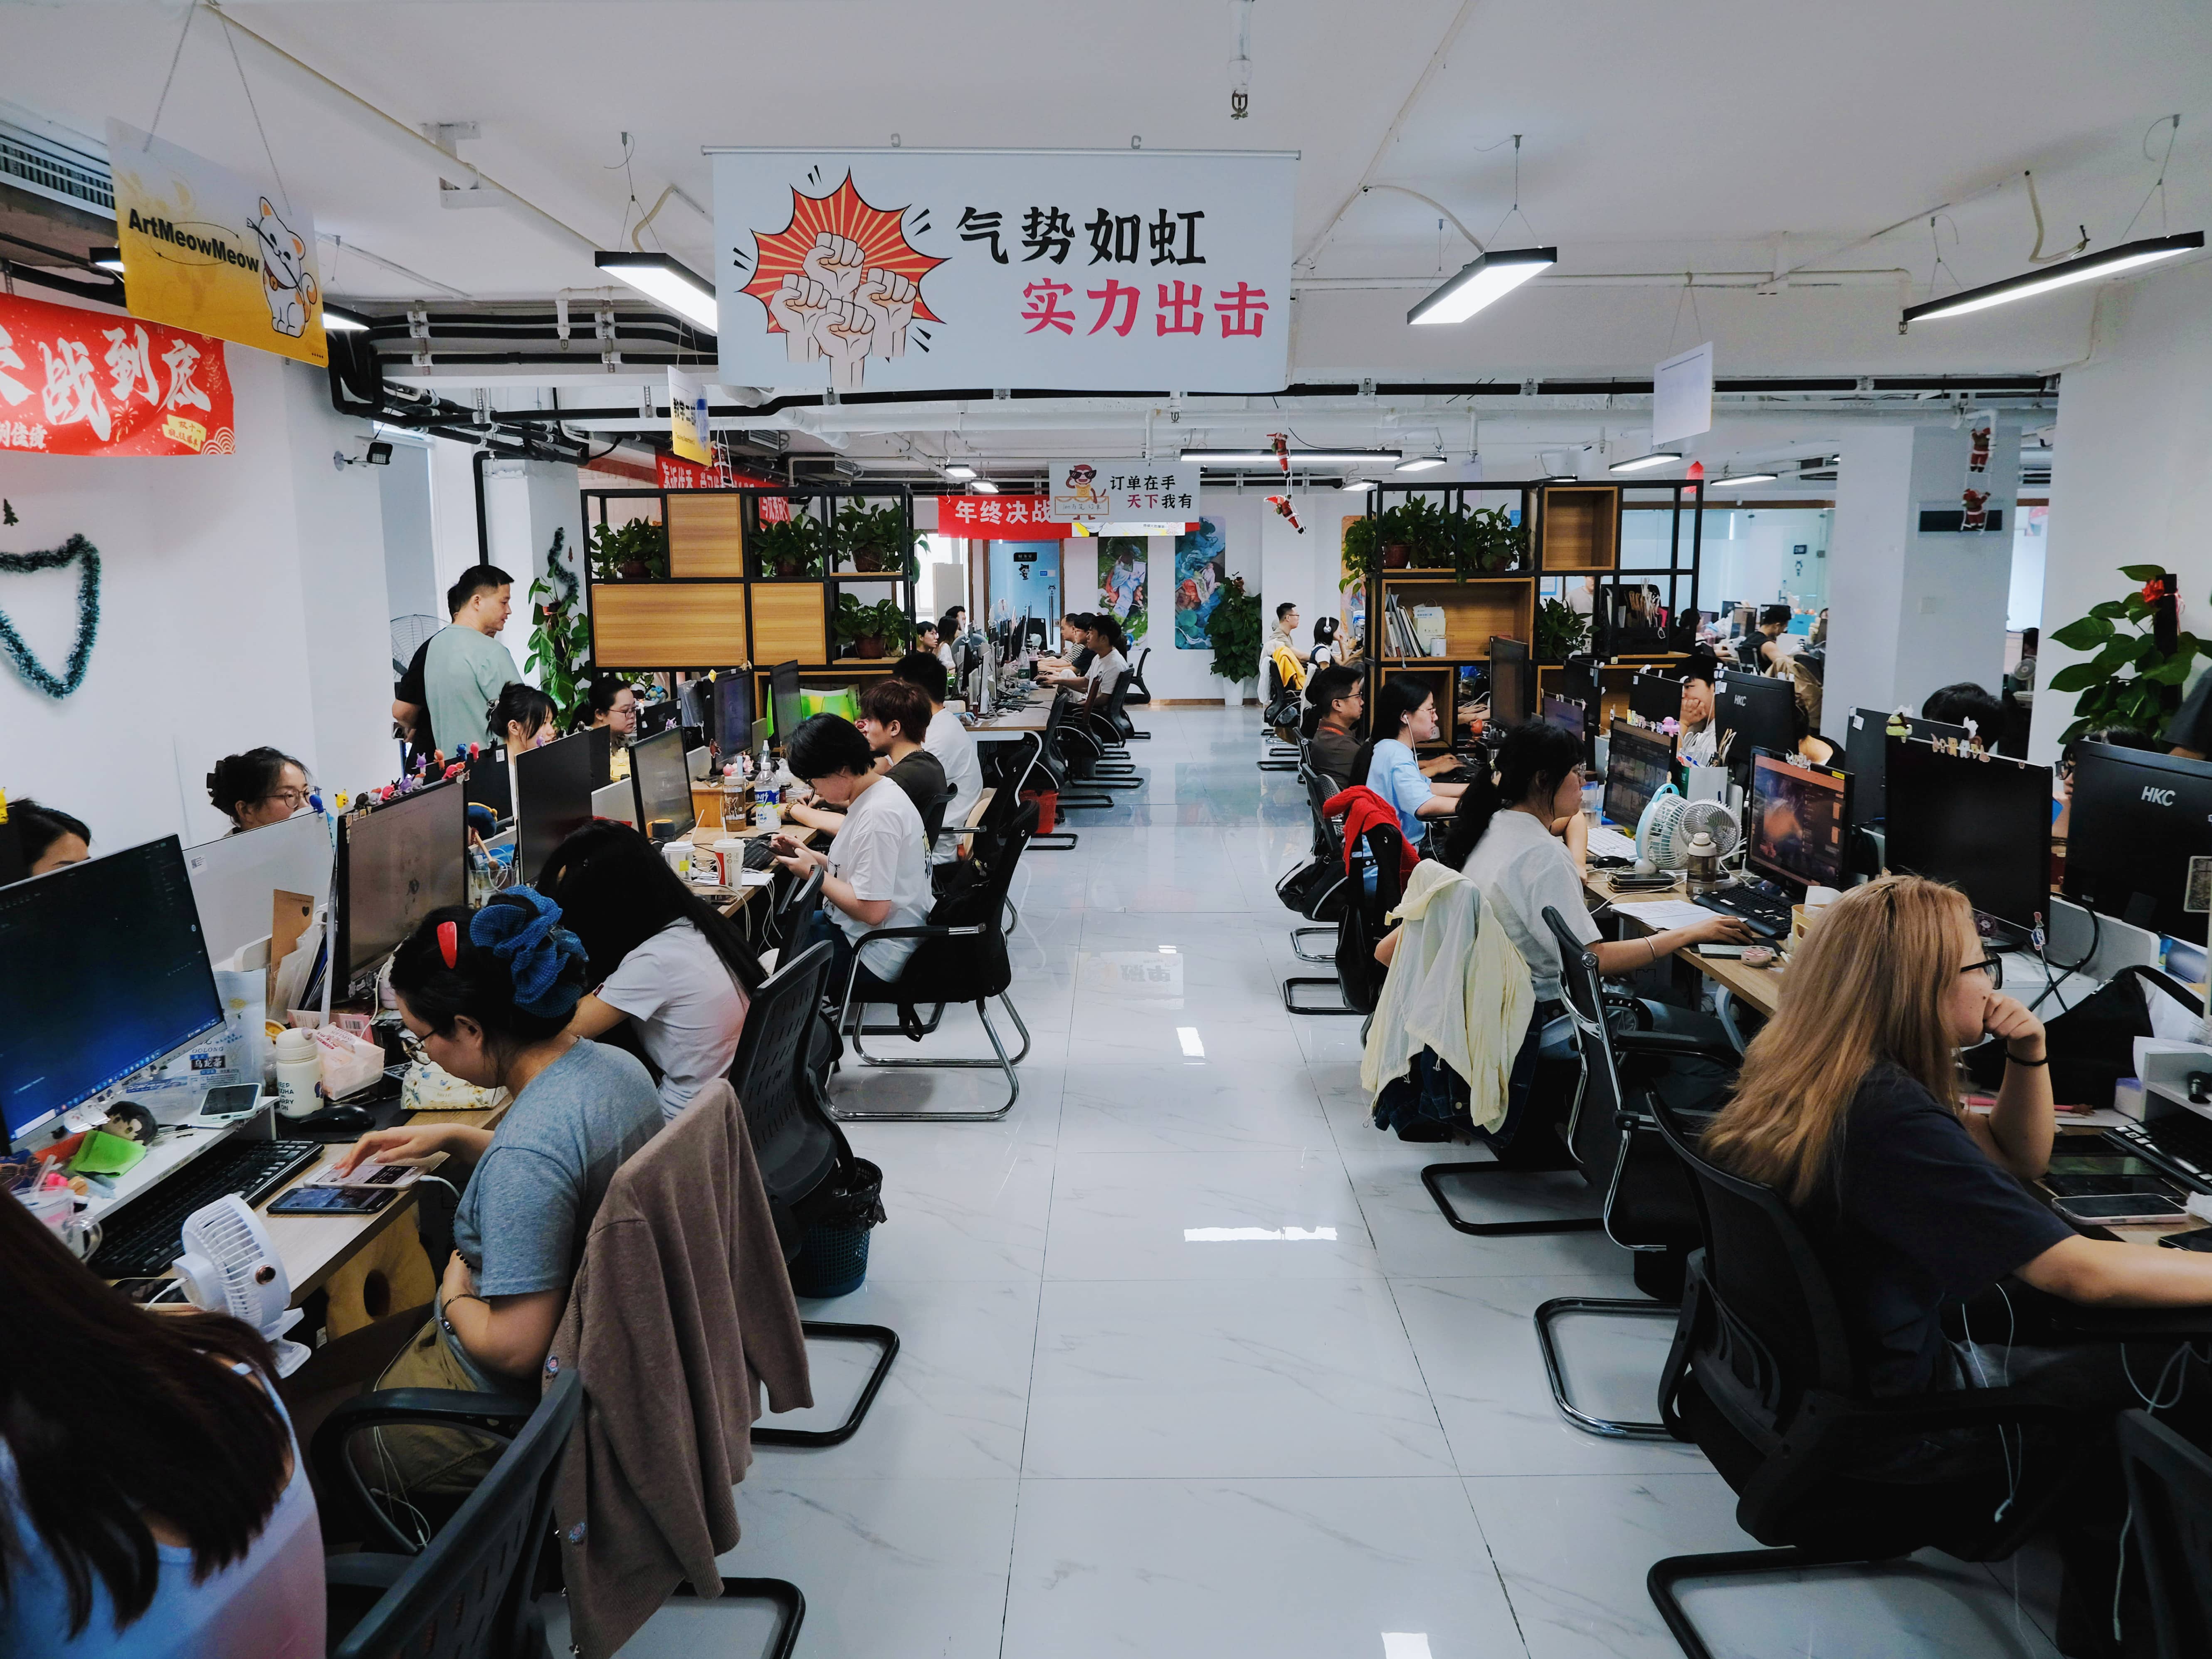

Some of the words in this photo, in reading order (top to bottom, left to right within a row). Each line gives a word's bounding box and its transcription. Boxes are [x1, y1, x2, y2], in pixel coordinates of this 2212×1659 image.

[128, 208, 259, 272] ArtMeowMeow
[956, 206, 1206, 267] 气势如虹
[1021, 278, 1270, 338] 实力出击
[178, 421, 201, 433] 双十一
[1109, 475, 1176, 491] 订单在手
[1127, 494, 1192, 509] 天下我有
[1734, 694, 1747, 707] HKC
[2141, 786, 2176, 807] HKC
[195, 1057, 222, 1069] 乌龙茶
